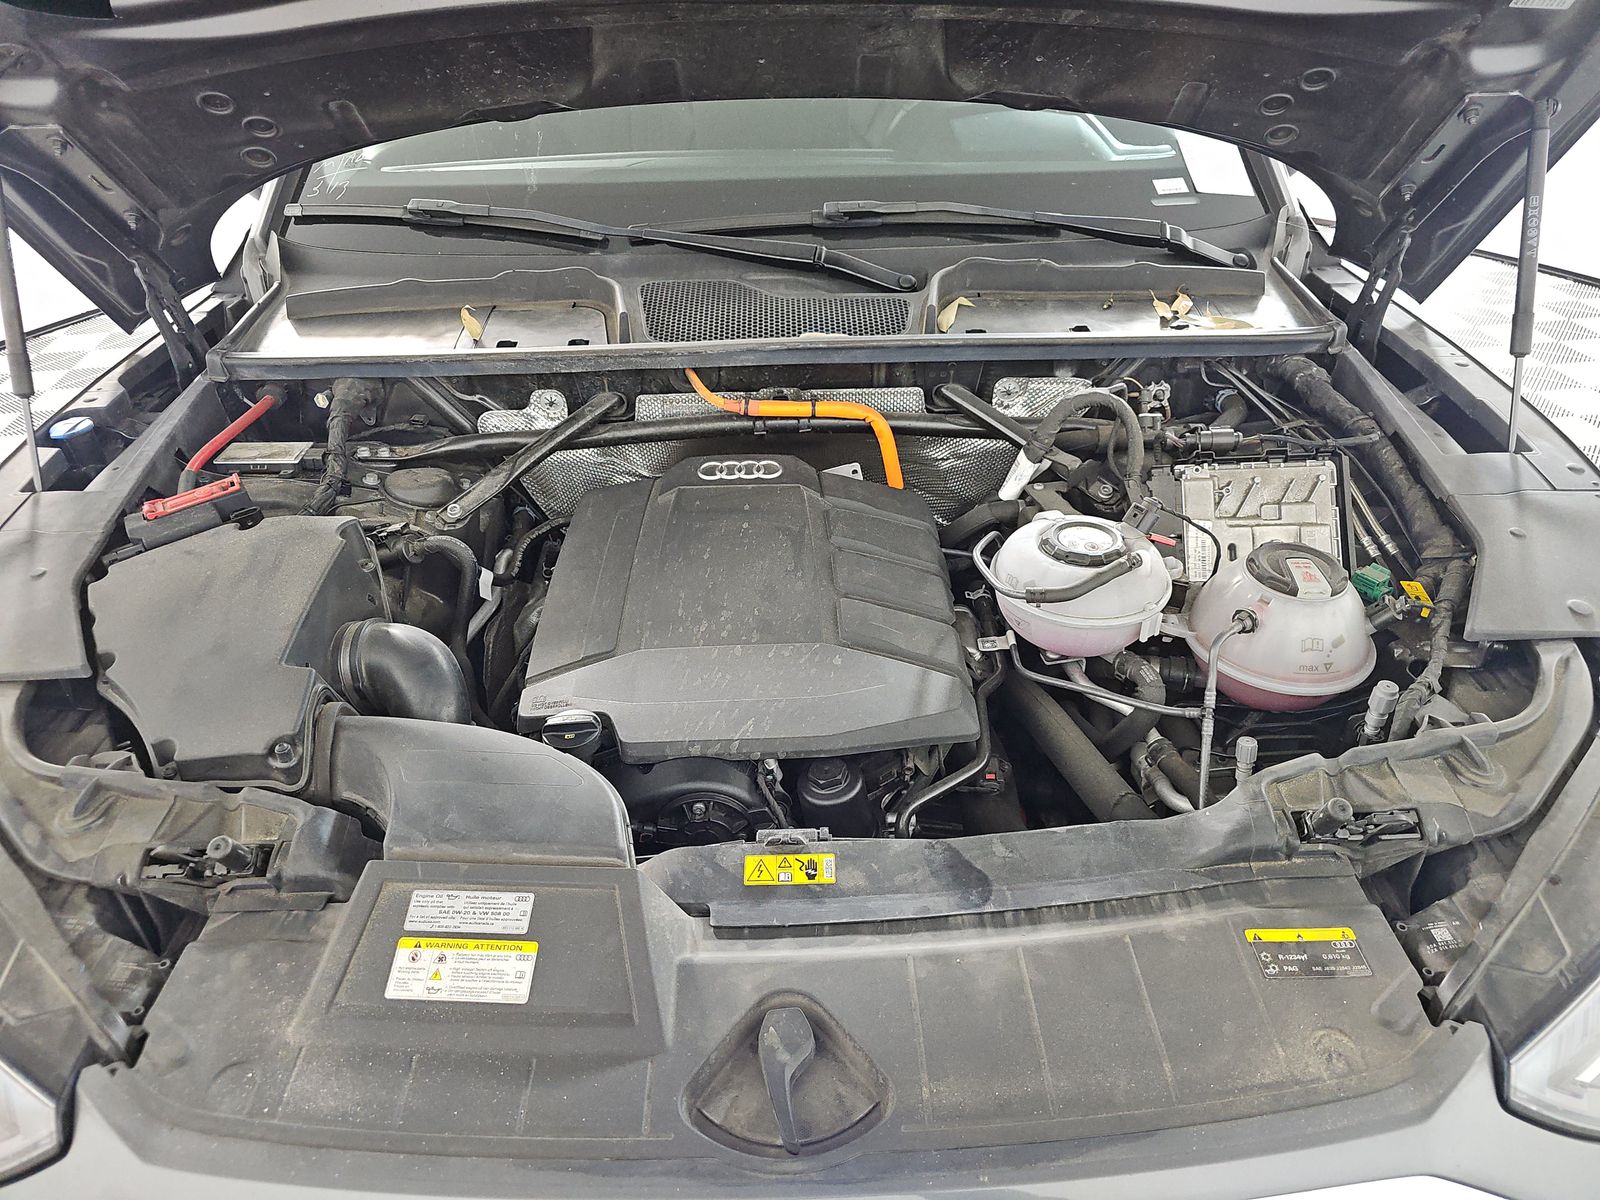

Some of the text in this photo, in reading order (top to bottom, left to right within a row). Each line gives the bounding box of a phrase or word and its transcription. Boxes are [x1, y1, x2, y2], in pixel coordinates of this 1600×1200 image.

[1298, 664, 1319, 673] max
[472, 943, 523, 951] ATTENTION
[1277, 953, 1308, 961] R-1234yf
[1341, 953, 1351, 961] kg
